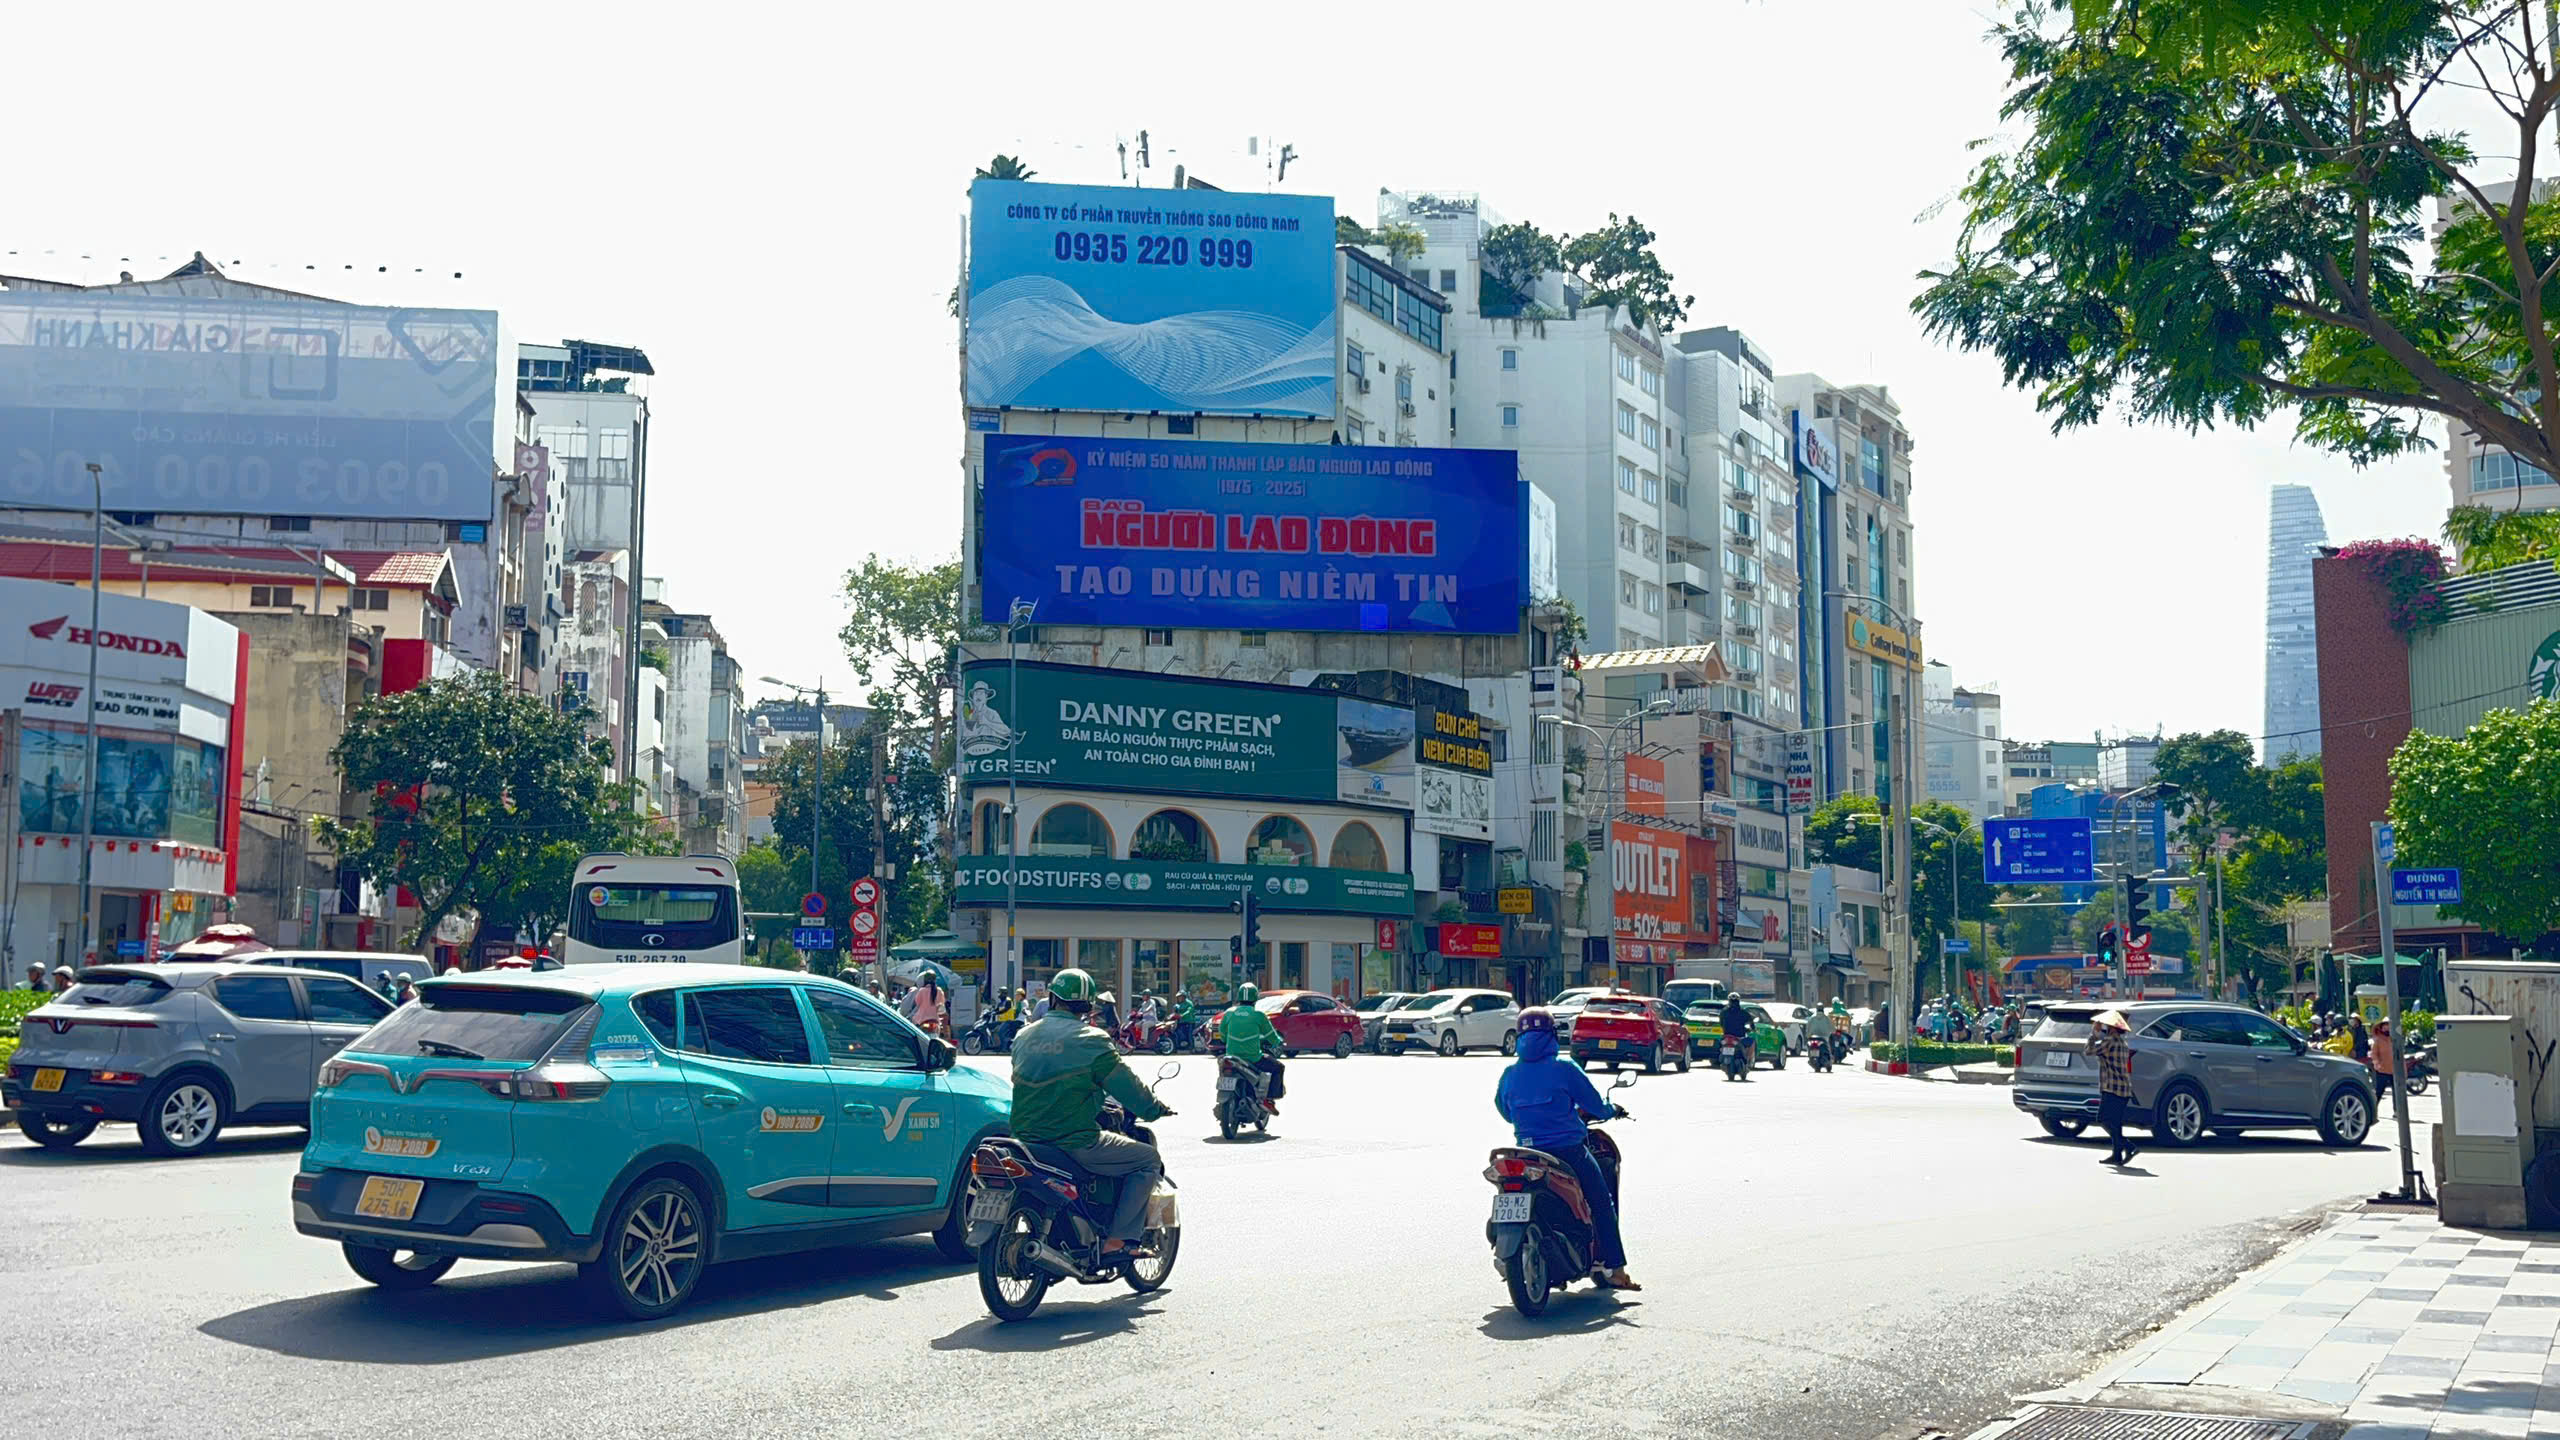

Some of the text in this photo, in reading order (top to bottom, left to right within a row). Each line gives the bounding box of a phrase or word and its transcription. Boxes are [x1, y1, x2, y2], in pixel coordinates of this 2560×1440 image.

[1007, 202, 1299, 232] CÔNG TY CỔ PHẦN TRUYỀN THÔNG SAO ĐÔNG NAM
[1055, 231, 1253, 269] 0935 220 999
[1109, 450, 1146, 471] NIỆM
[1150, 453, 1168, 468] 50
[1366, 460, 1390, 476] LAO
[1081, 509, 1434, 556] NGƯỜI LAO ĐỘNG
[1055, 563, 1458, 602] TẠO DỰNG NIỀM TIN
[68, 626, 188, 659] HONDA
[102, 689, 126, 700] TRUNG
[1060, 700, 1272, 738] DANNY GREEN
[1062, 727, 1090, 742] ĐẢM
[1093, 728, 1120, 744] BẢO
[1169, 736, 1202, 751] THỰC
[1241, 741, 1275, 758] SẠCH,
[1446, 743, 1466, 766] CUA
[980, 759, 1050, 775] GREEN
[1084, 749, 1102, 761] AN
[1105, 749, 1139, 763] TOÀN
[1142, 753, 1168, 766] CHO
[1171, 756, 1191, 768] GIA
[1194, 755, 1222, 770] ĐÌNH
[1225, 759, 1249, 774] BẠN
[1786, 764, 1812, 774] KHOA
[1790, 752, 1808, 761] NHA
[1787, 776, 1812, 788] TÂM
[1739, 823, 1784, 853] NHA KHOA
[974, 868, 1102, 888] FOODSTUFFS
[1165, 872, 1180, 880] RAU
[1612, 839, 1680, 897] OUTLET
[1634, 913, 1661, 940] 50%
[775, 1116, 794, 1129] 1900
[908, 1117, 940, 1129] XANH SM
